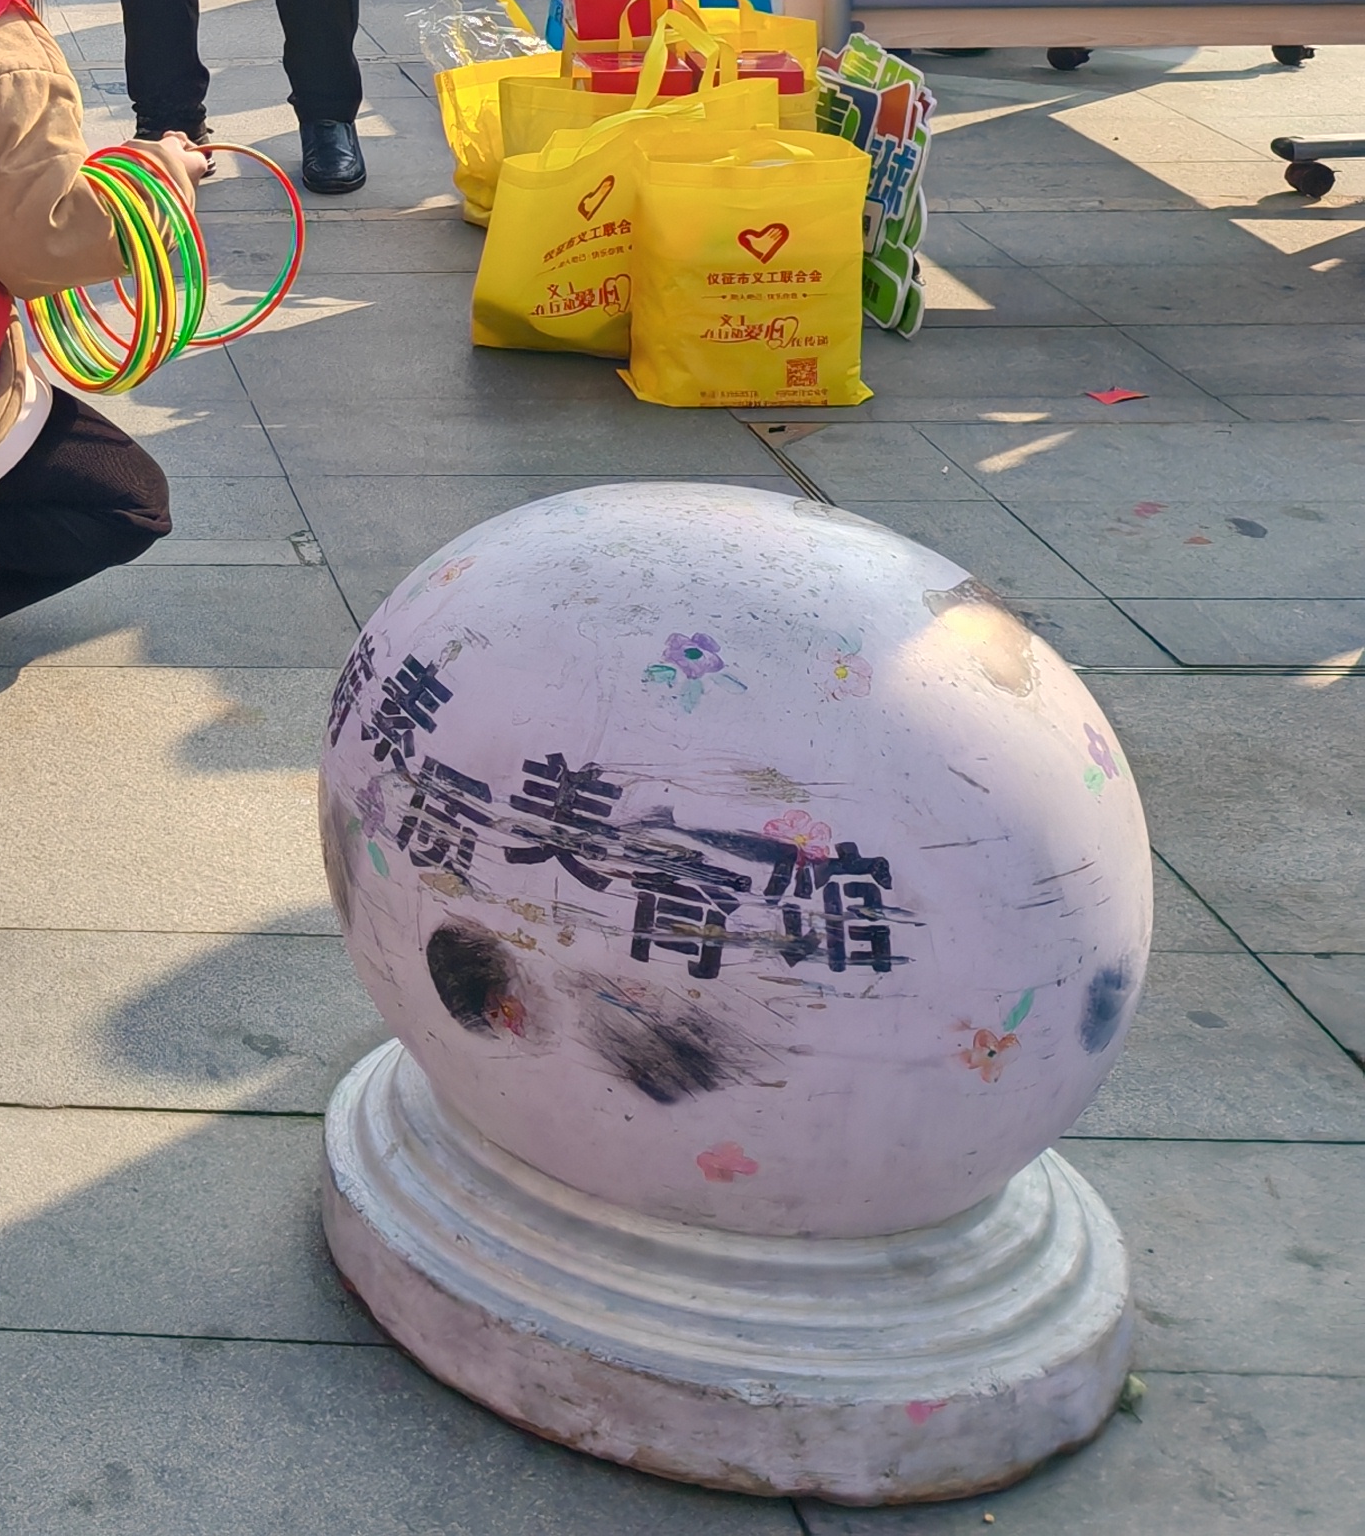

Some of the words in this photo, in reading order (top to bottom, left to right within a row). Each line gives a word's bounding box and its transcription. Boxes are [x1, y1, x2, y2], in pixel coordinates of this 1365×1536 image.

[706, 269, 823, 286] 仪征市义工联合会
